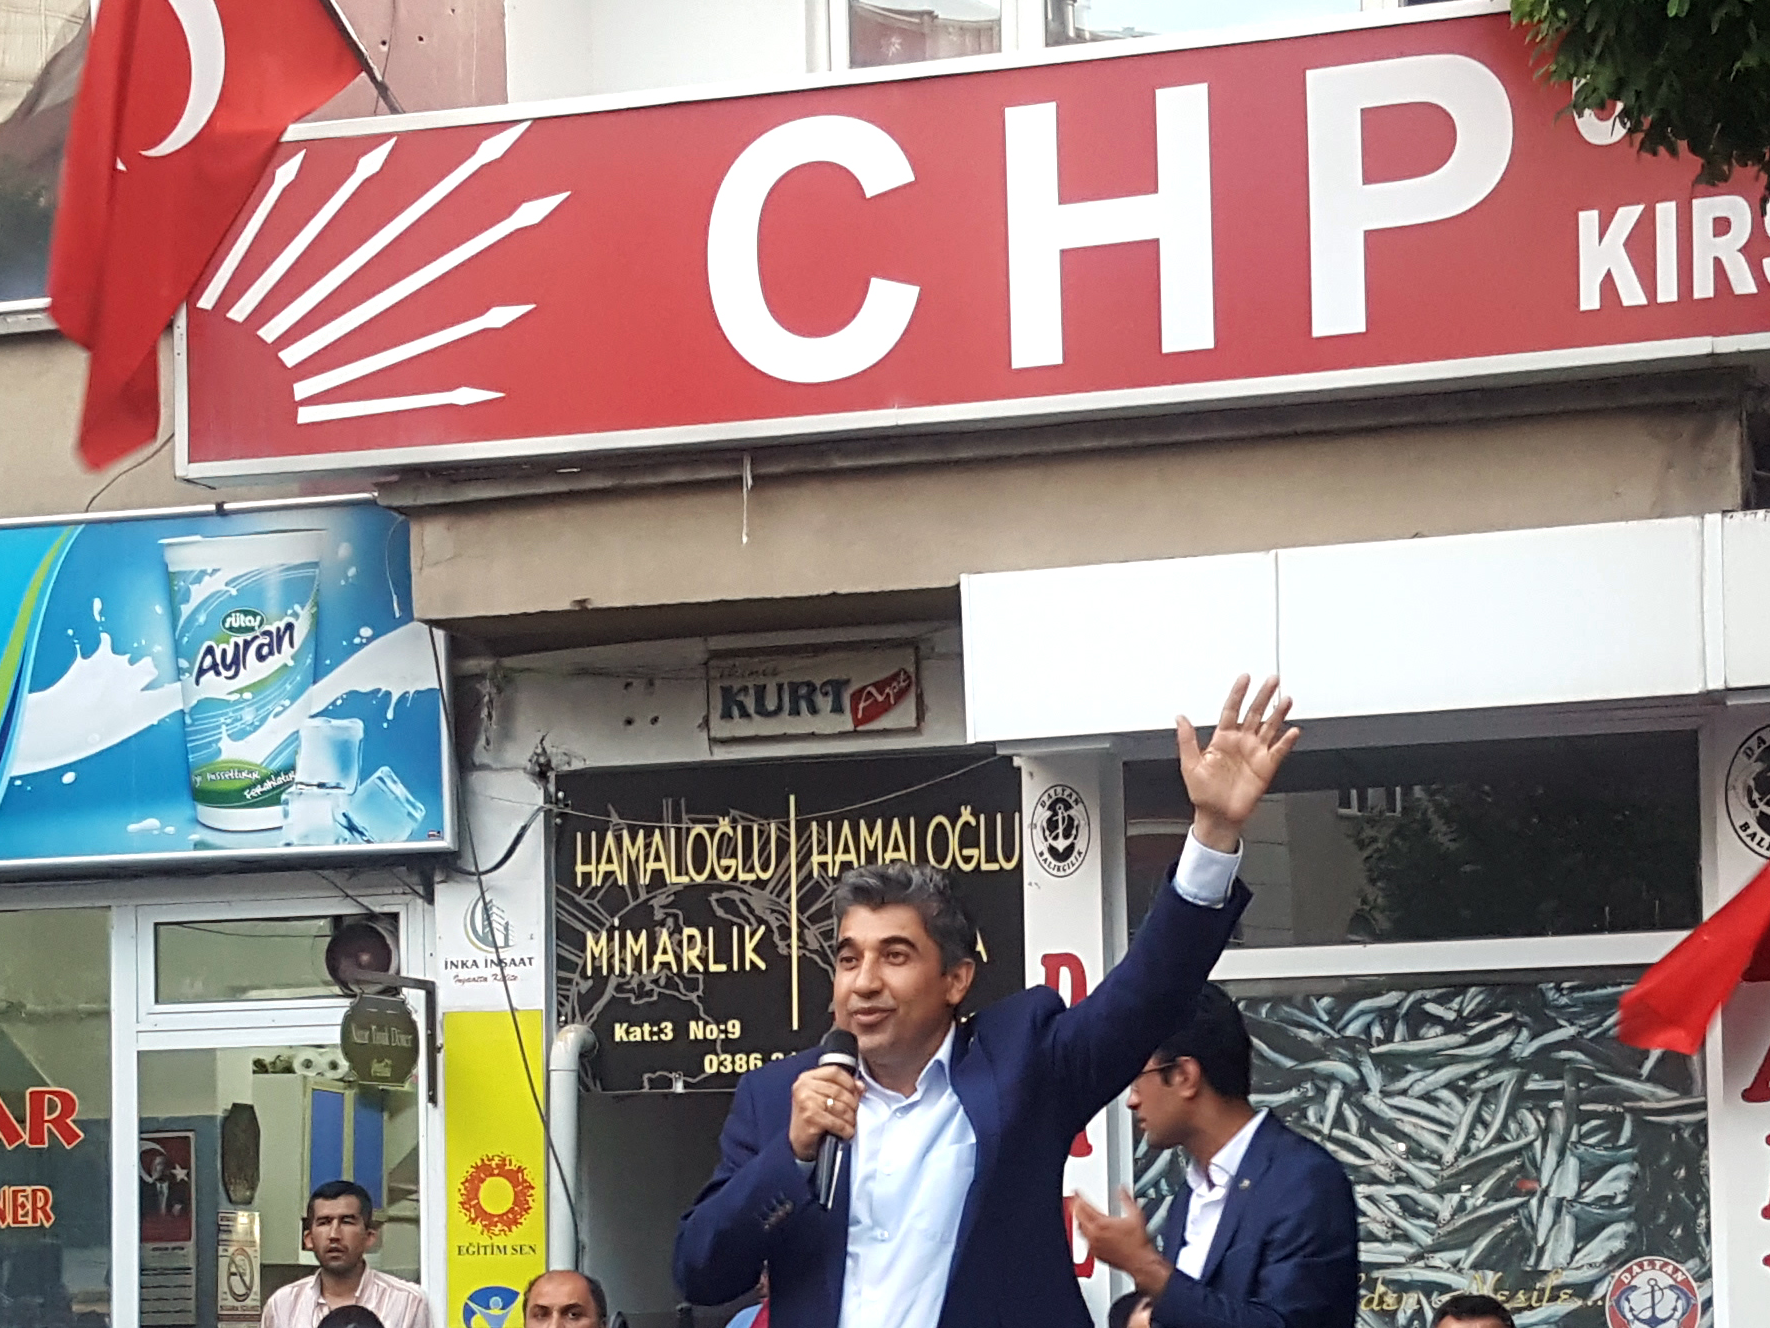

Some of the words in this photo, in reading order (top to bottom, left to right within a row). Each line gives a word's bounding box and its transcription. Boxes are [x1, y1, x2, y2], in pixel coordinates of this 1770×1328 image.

[706, 53, 1514, 384] CHP
[194, 620, 295, 687] Ayran
[719, 678, 852, 720] KURT
[857, 668, 910, 719] Apt
[574, 816, 777, 888] HAMALOĞLU
[444, 958, 479, 971] İNKA
[585, 917, 767, 977] MİMARLIK
[614, 1021, 674, 1043] Kat:3
[689, 1020, 741, 1041] No:9
[704, 1053, 763, 1075] 0386
[457, 1242, 508, 1256] EĞİTİM
[511, 1244, 537, 1256] SEN
[1620, 1260, 1687, 1285] DALYAN
